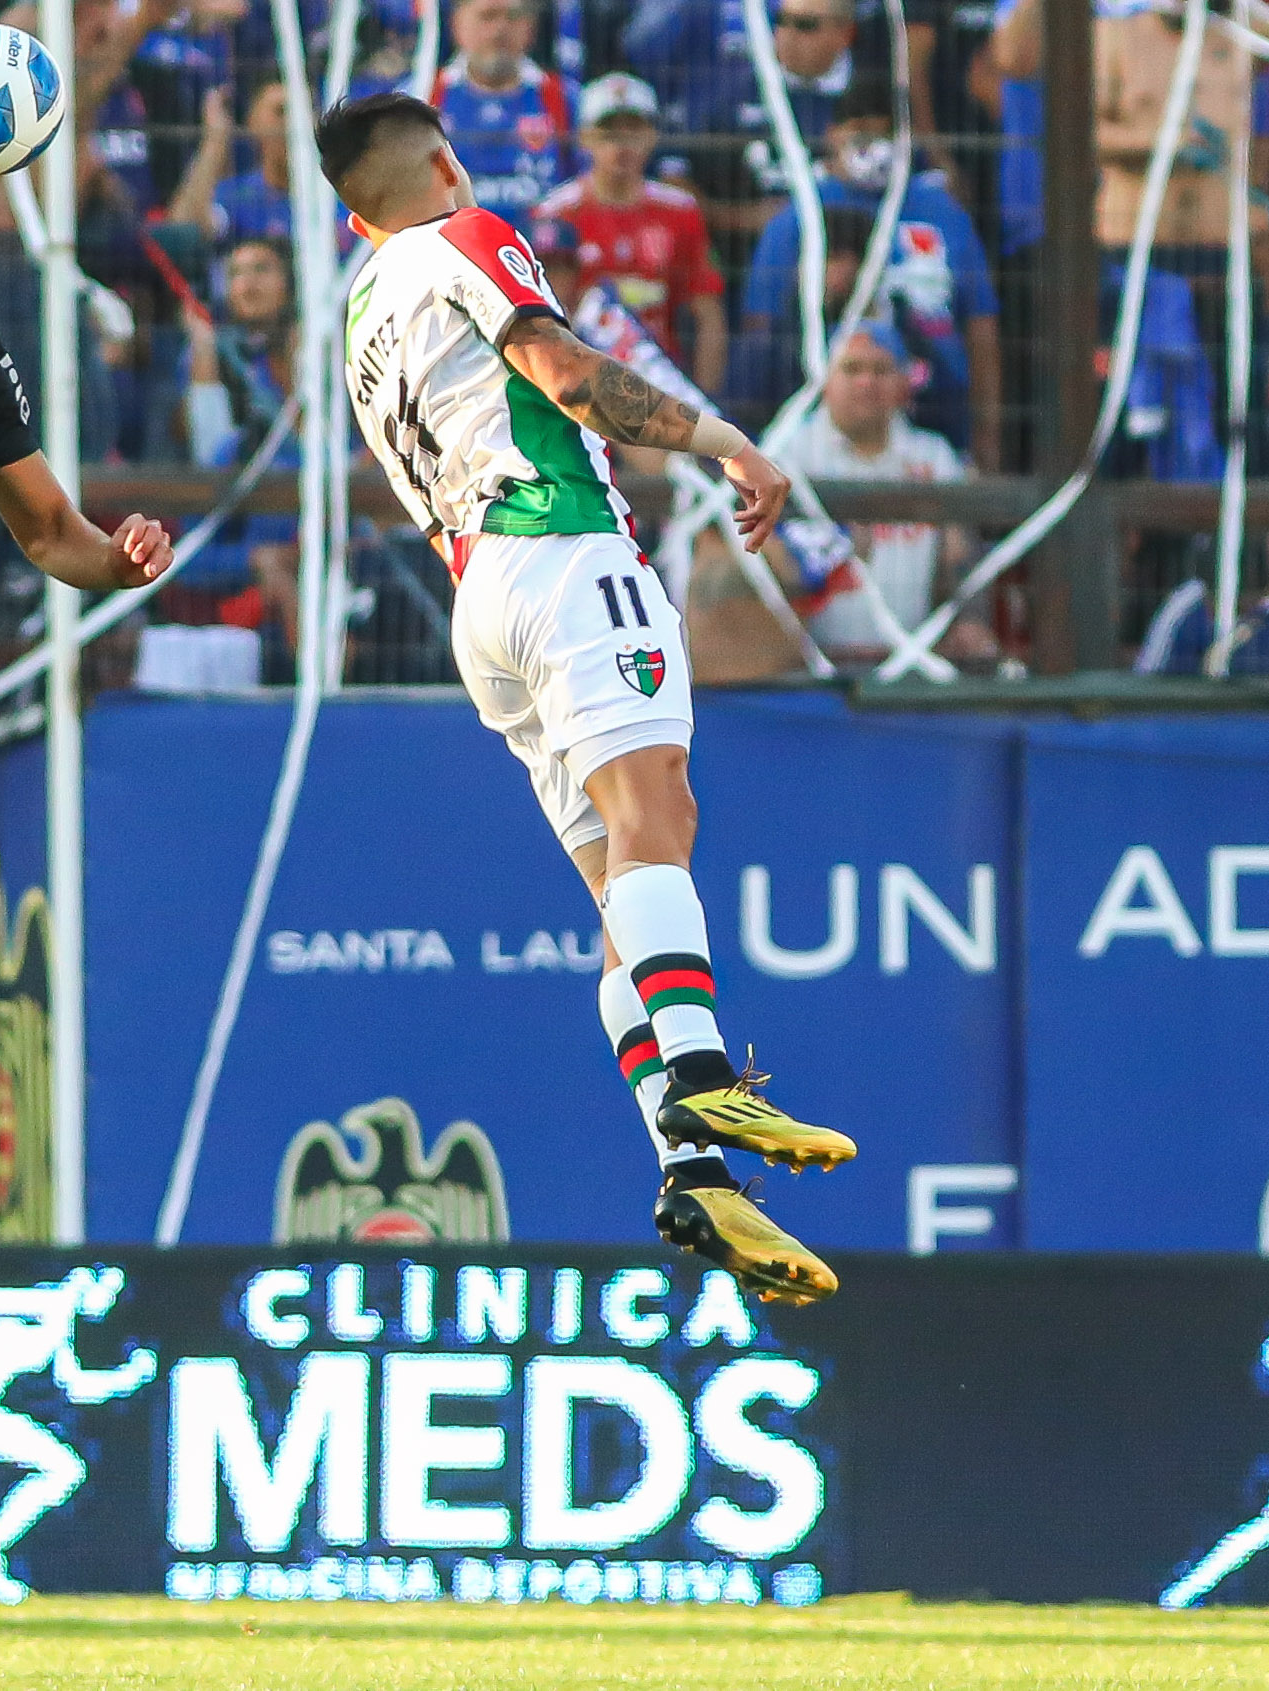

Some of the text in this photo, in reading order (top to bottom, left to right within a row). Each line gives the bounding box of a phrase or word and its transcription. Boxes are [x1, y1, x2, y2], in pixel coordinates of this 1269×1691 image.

[357, 311, 400, 407] ENITEZ
[595, 573, 652, 631] 11
[268, 929, 454, 972] SANTA
[740, 861, 999, 980] UN
[240, 1264, 758, 1350] CLINICA
[165, 1350, 826, 1561] MEDS
